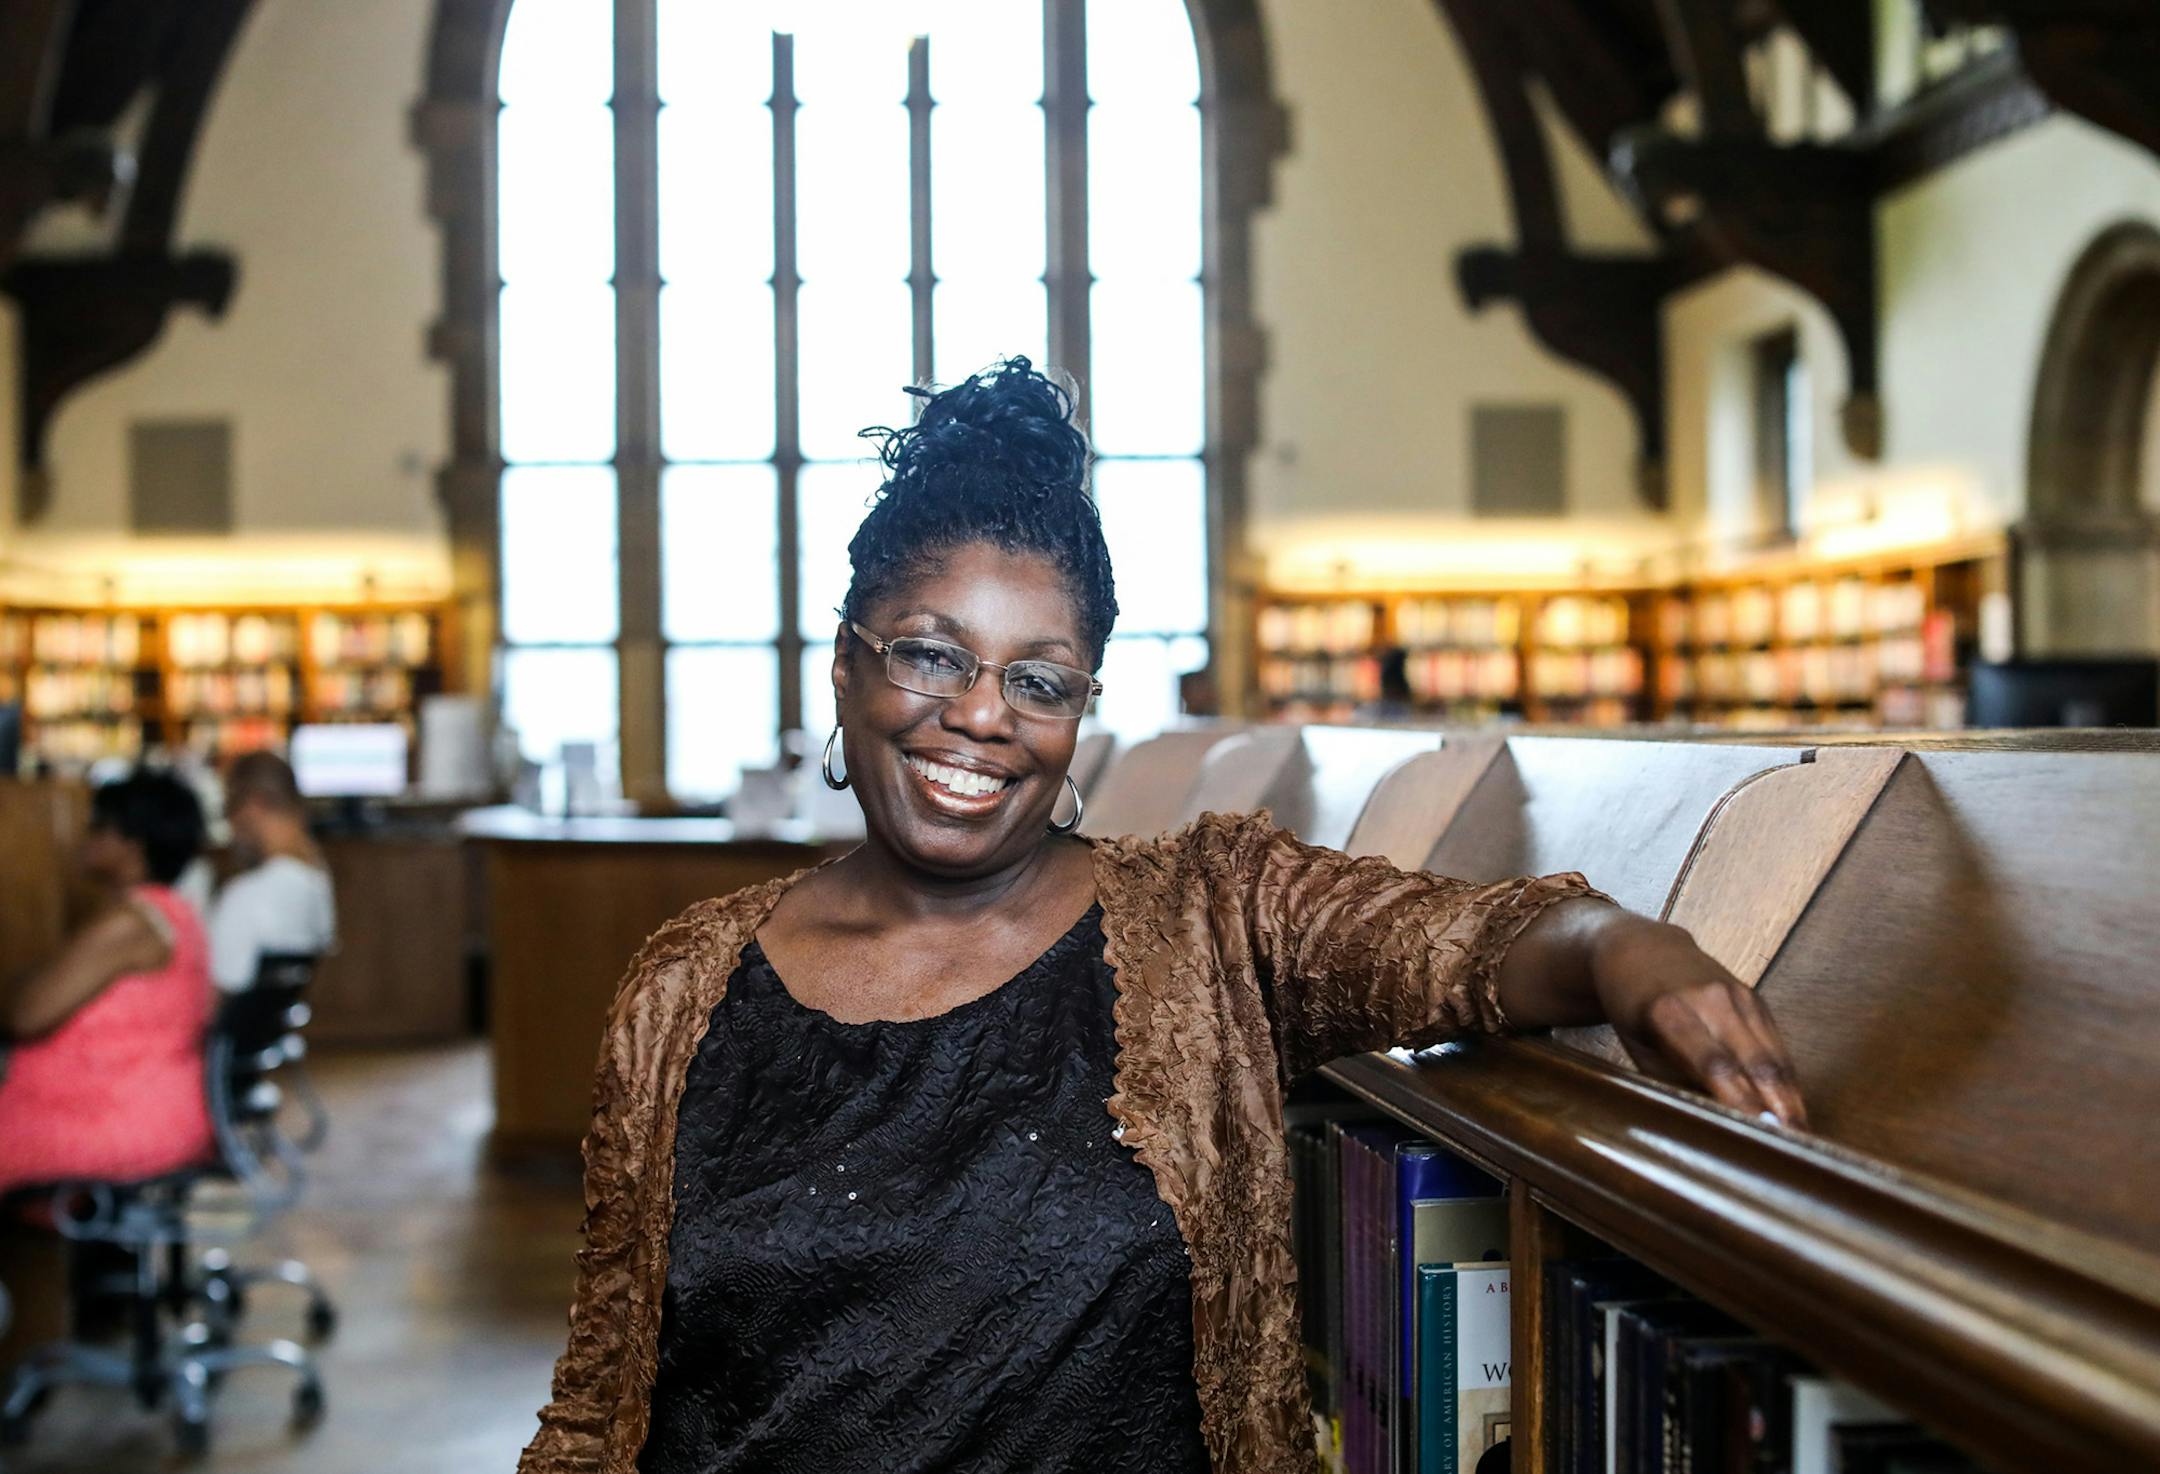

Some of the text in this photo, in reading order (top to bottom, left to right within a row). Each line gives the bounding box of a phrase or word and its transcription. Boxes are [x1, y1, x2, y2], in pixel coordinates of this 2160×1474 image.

[1486, 1282, 1511, 1293] A B
[1443, 1286, 1453, 1344] HISTORY
[1443, 1352, 1453, 1424] AMERICAN
[1483, 1362, 1511, 1382] W
